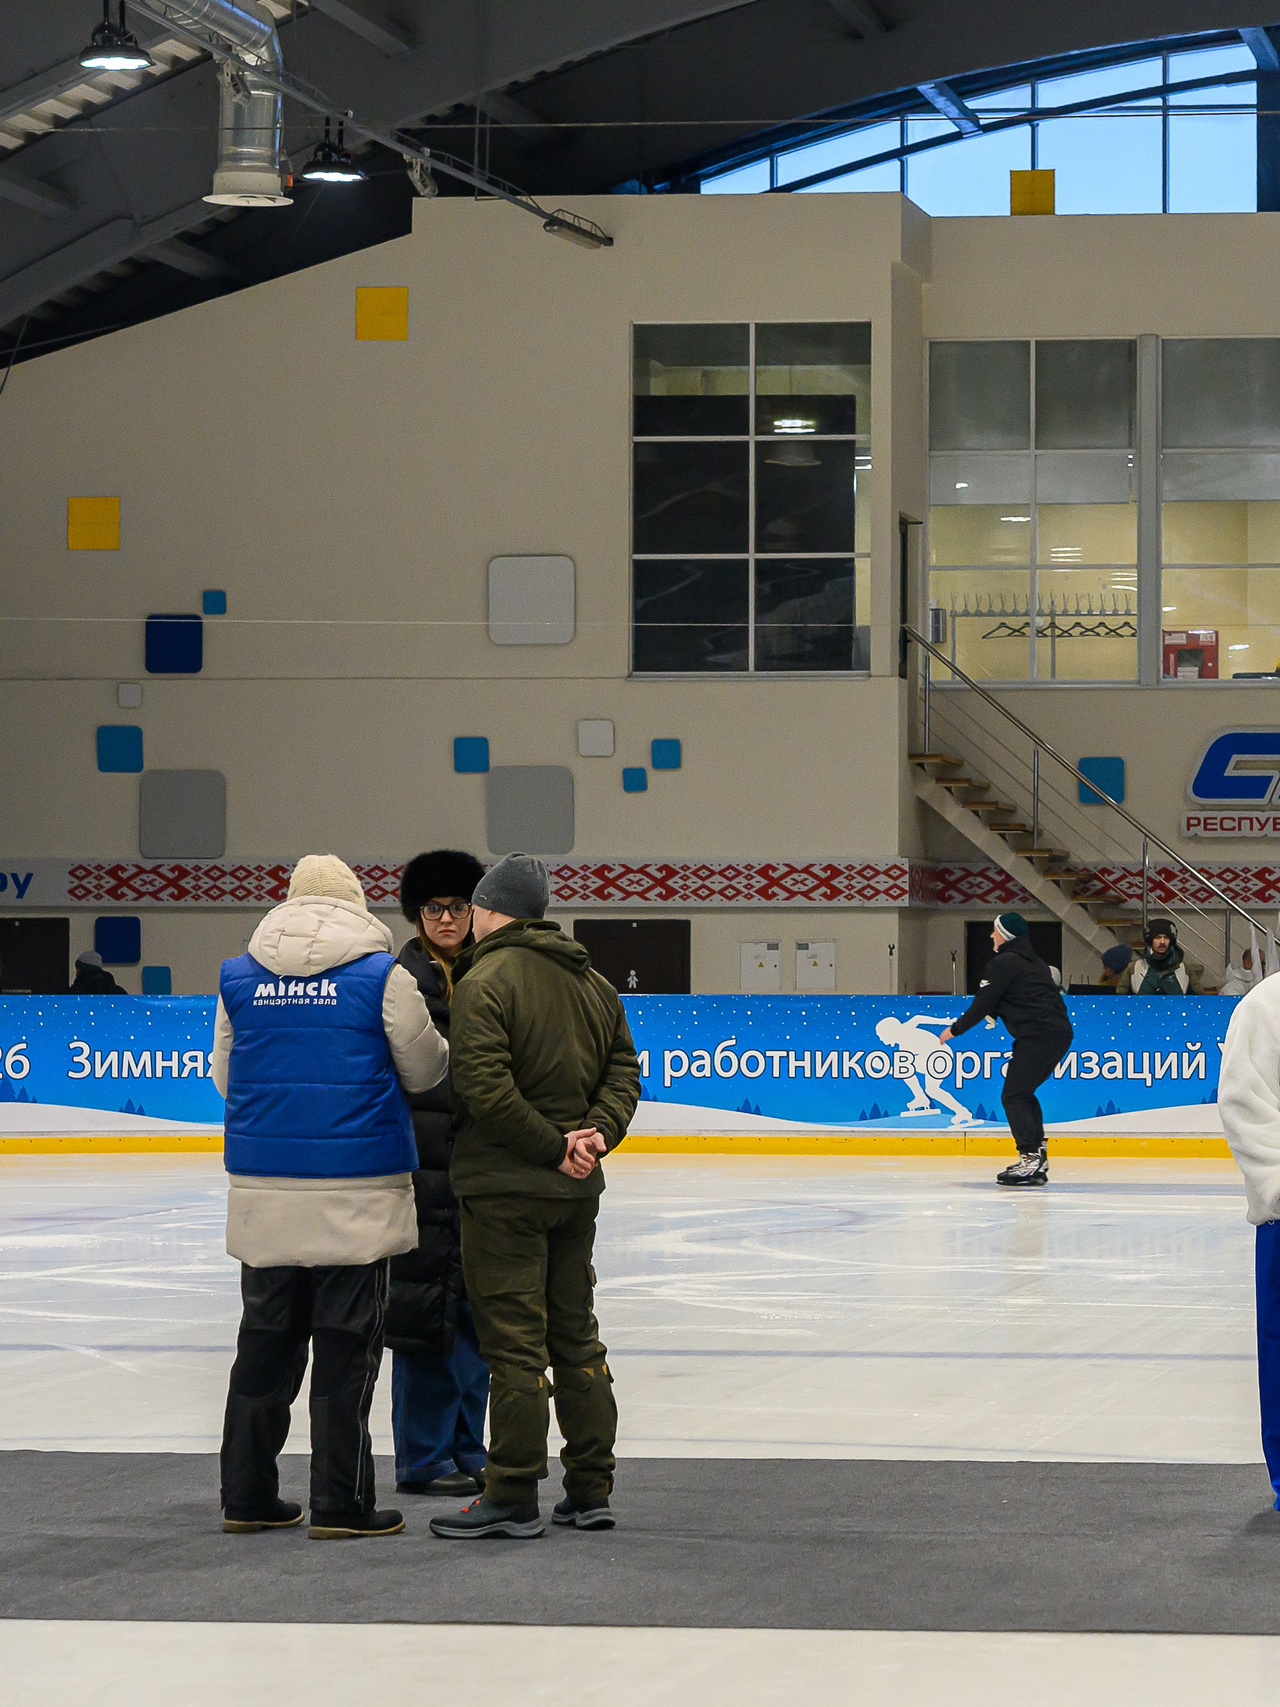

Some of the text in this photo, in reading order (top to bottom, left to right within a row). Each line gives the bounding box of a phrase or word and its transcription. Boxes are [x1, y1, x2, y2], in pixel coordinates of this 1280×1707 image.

[253, 998, 337, 1007] канцэртная зала
[0, 1042, 31, 1080] 6
[663, 1038, 916, 1088] работников
[926, 1041, 1207, 1089] оргизаций
